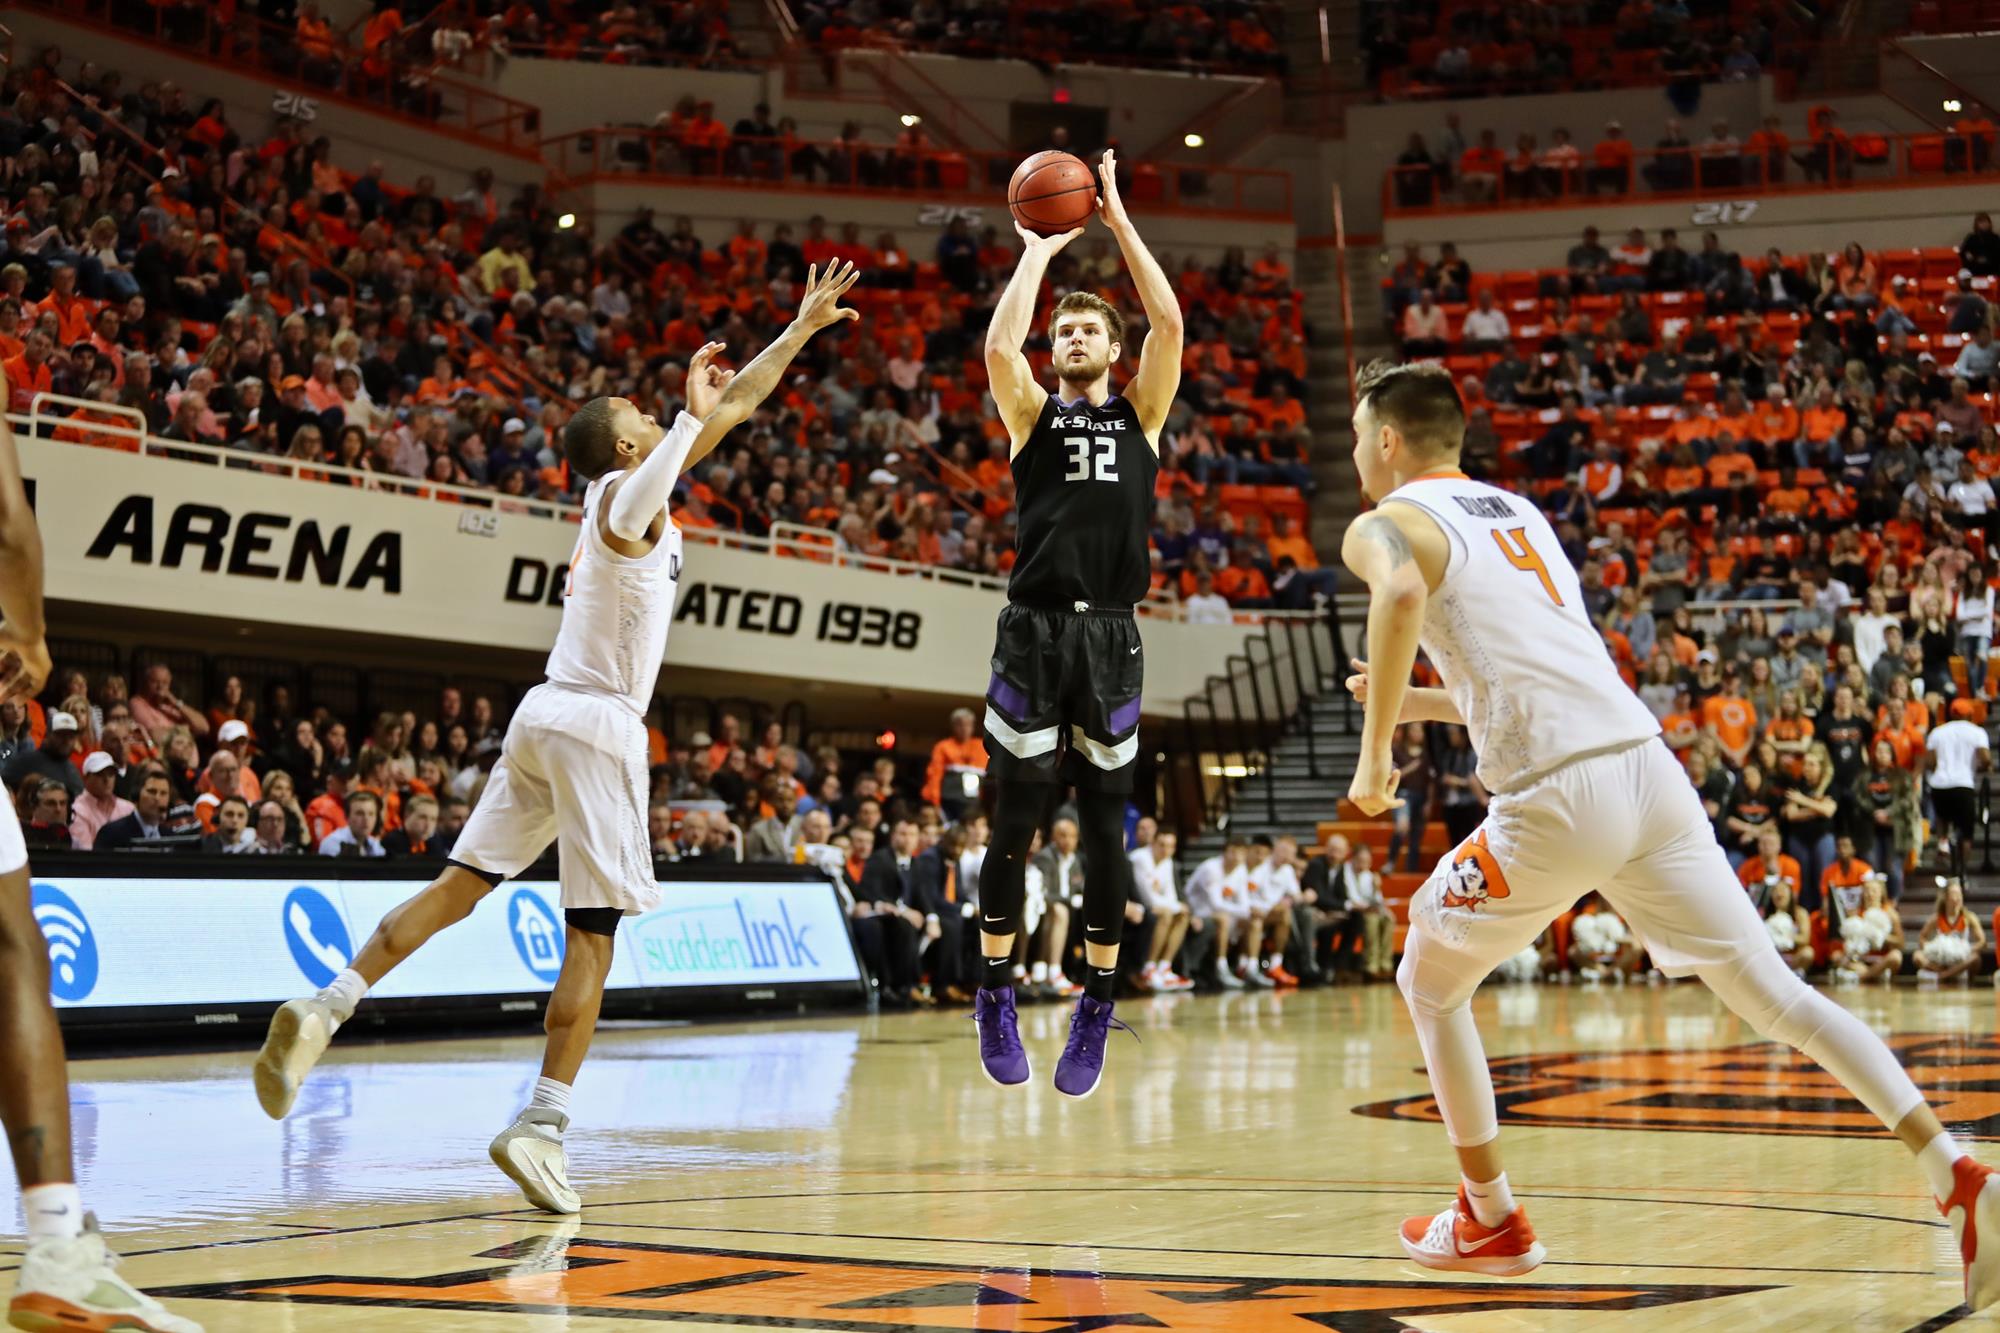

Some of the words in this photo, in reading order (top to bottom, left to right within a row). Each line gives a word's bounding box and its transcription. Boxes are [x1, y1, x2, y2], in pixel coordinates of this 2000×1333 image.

[1691, 201, 1758, 225] 217
[1064, 436, 1119, 482] 32
[84, 494, 402, 595] ARENA
[1490, 526, 1565, 607] 4
[817, 601, 921, 651] 1938
[643, 897, 820, 973] suddenlink
